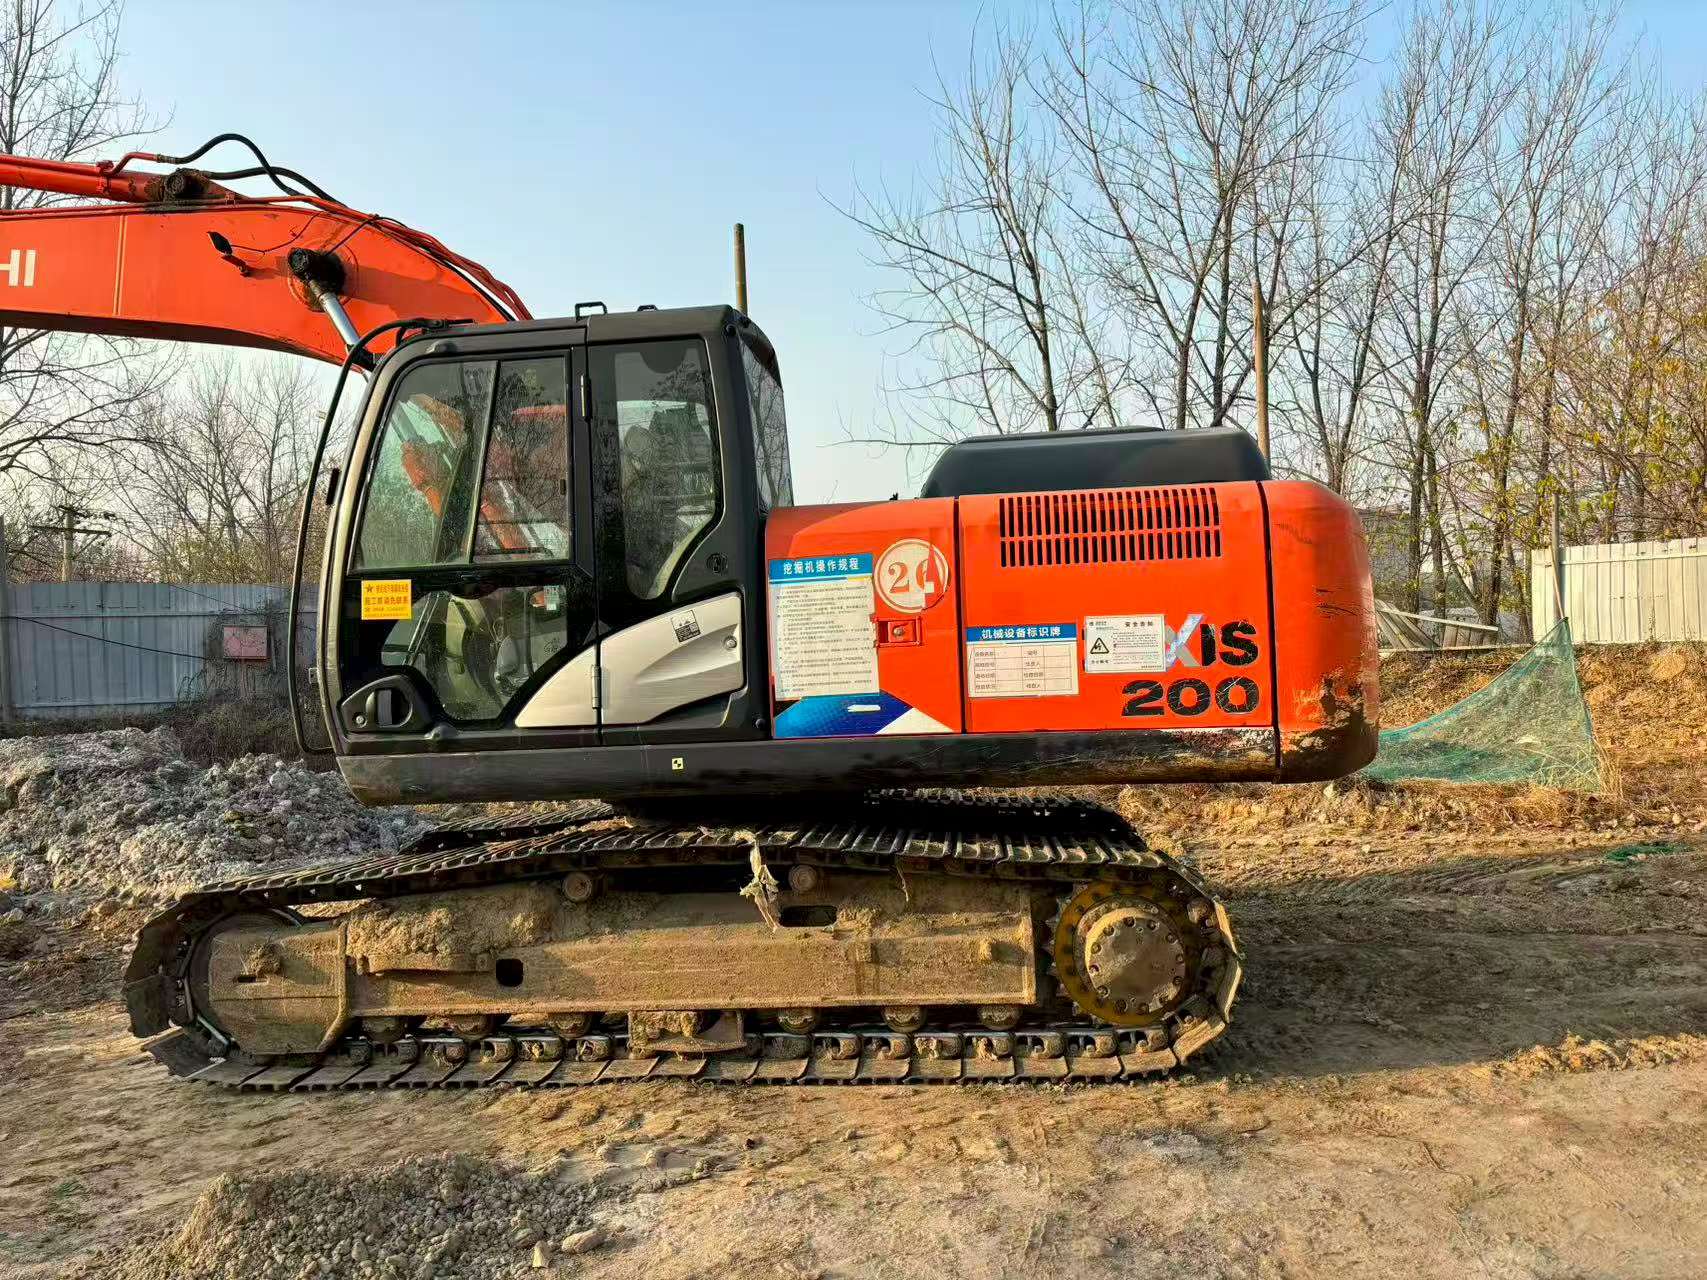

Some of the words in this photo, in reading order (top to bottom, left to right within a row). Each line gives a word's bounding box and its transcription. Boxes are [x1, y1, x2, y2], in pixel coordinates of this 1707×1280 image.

[783, 557, 859, 575] 挖掘机操作规程
[981, 626, 1061, 640] 机械设备标识牌
[1121, 676, 1260, 717] 200
